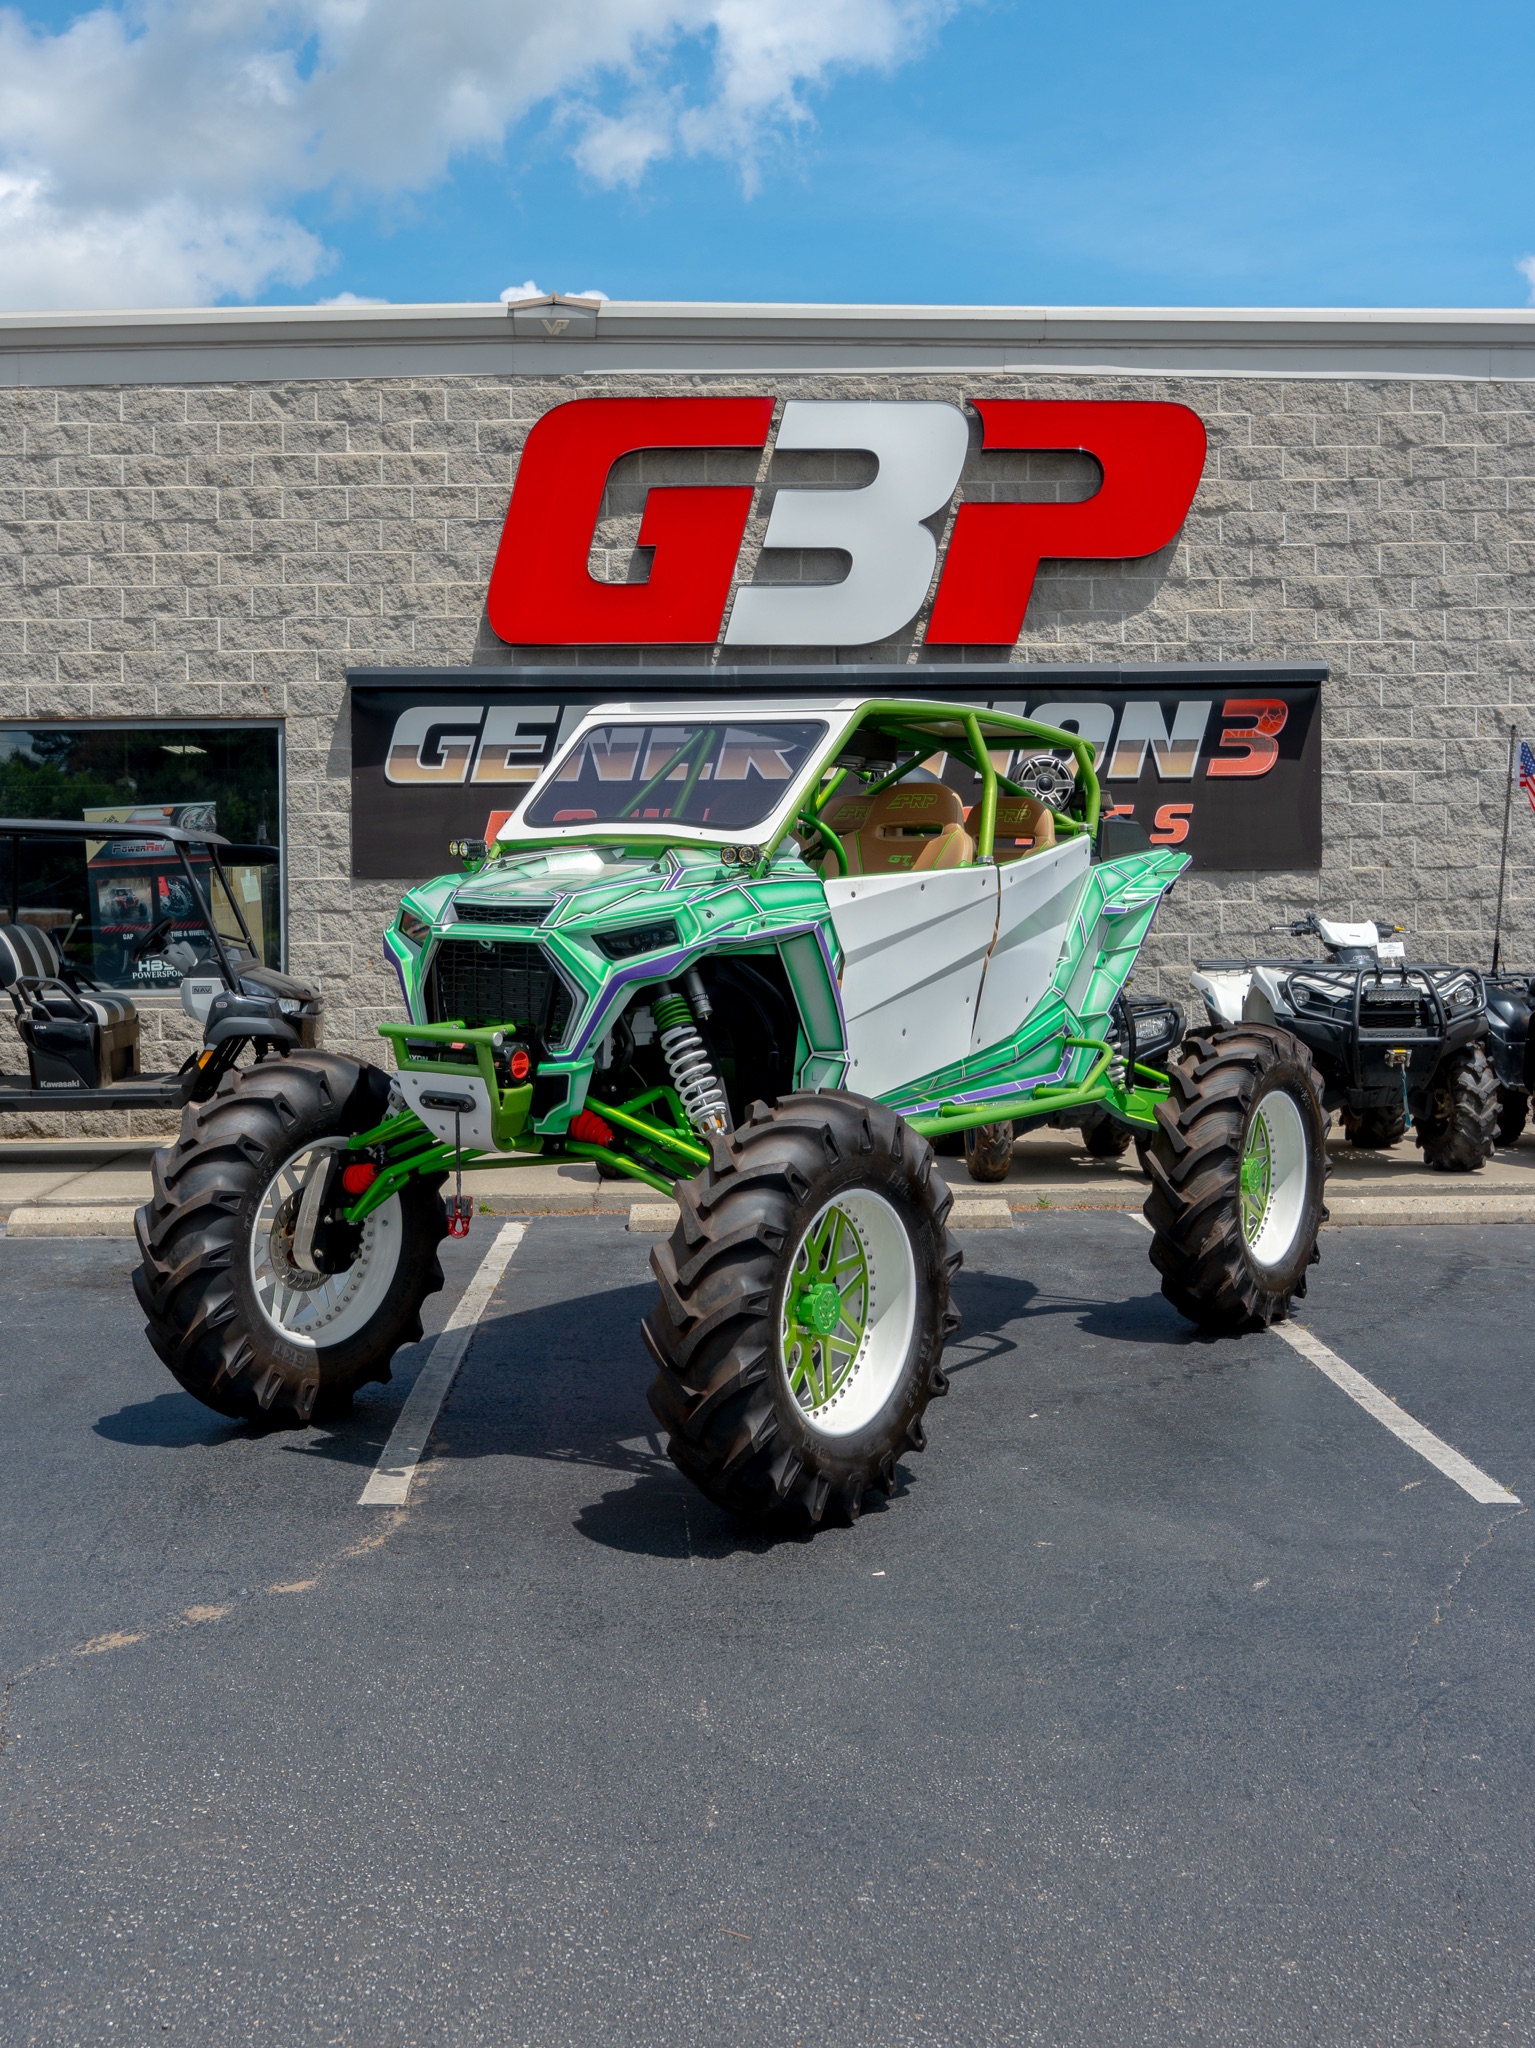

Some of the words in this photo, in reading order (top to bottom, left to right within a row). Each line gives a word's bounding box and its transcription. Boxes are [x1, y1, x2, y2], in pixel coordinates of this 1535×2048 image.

[886, 793, 939, 809] PRP
[833, 805, 869, 819] PR
[40, 1080, 80, 1088] Kawasaki
